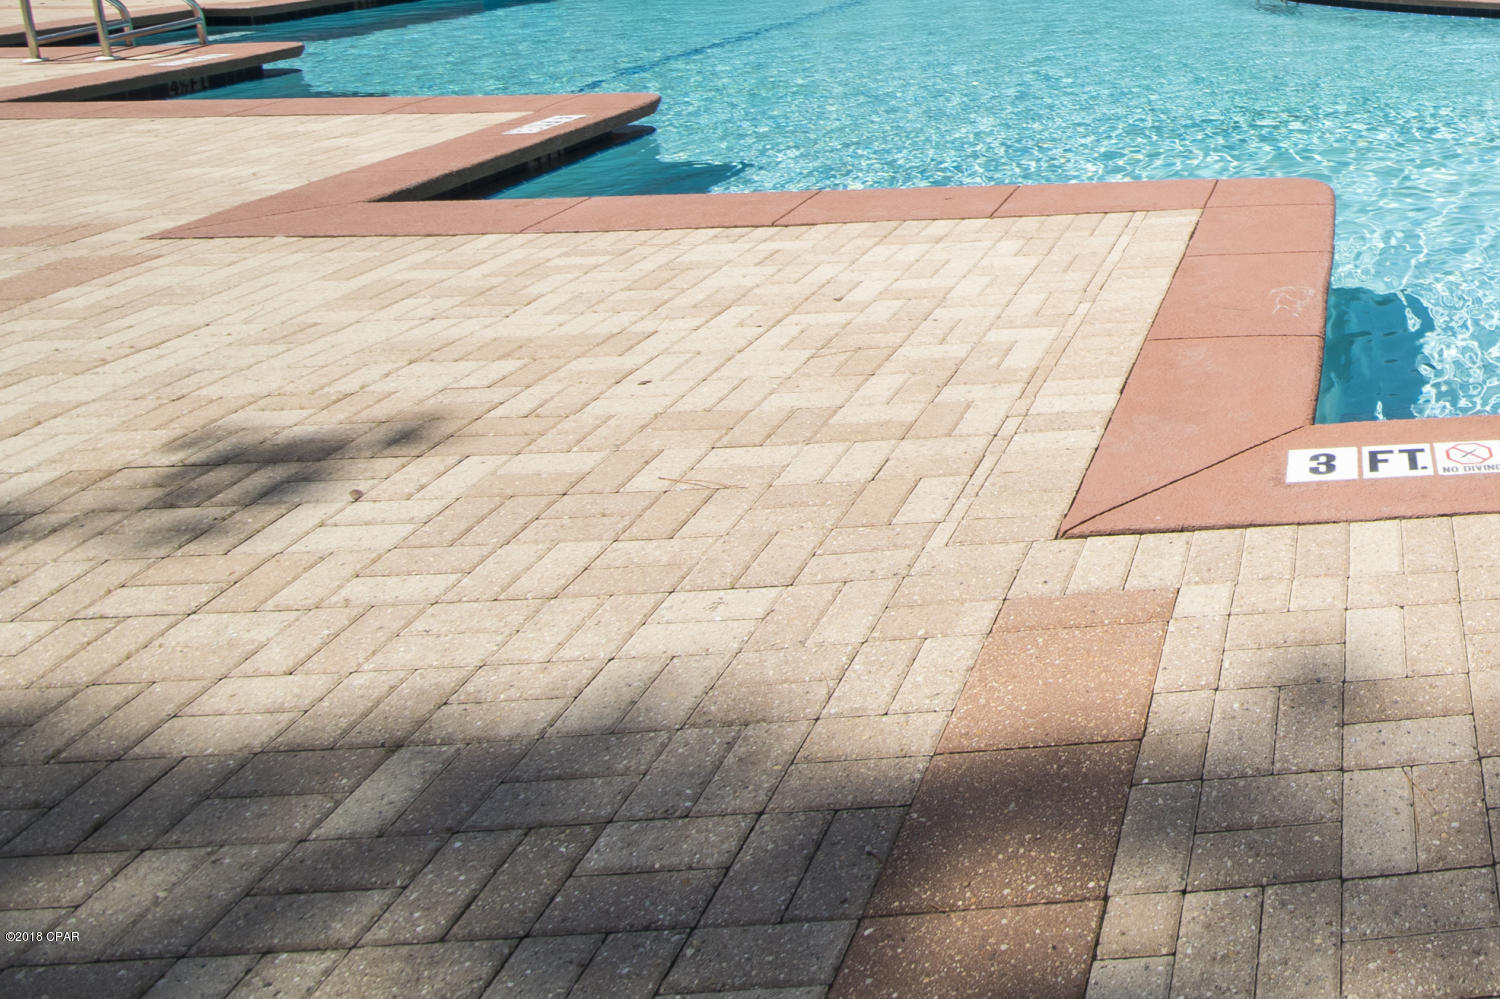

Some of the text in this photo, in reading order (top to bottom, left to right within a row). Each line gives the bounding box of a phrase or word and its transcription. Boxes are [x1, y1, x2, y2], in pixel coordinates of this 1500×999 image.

[1308, 447, 1429, 475] 3 FT.
[1442, 465, 1459, 474] NO
